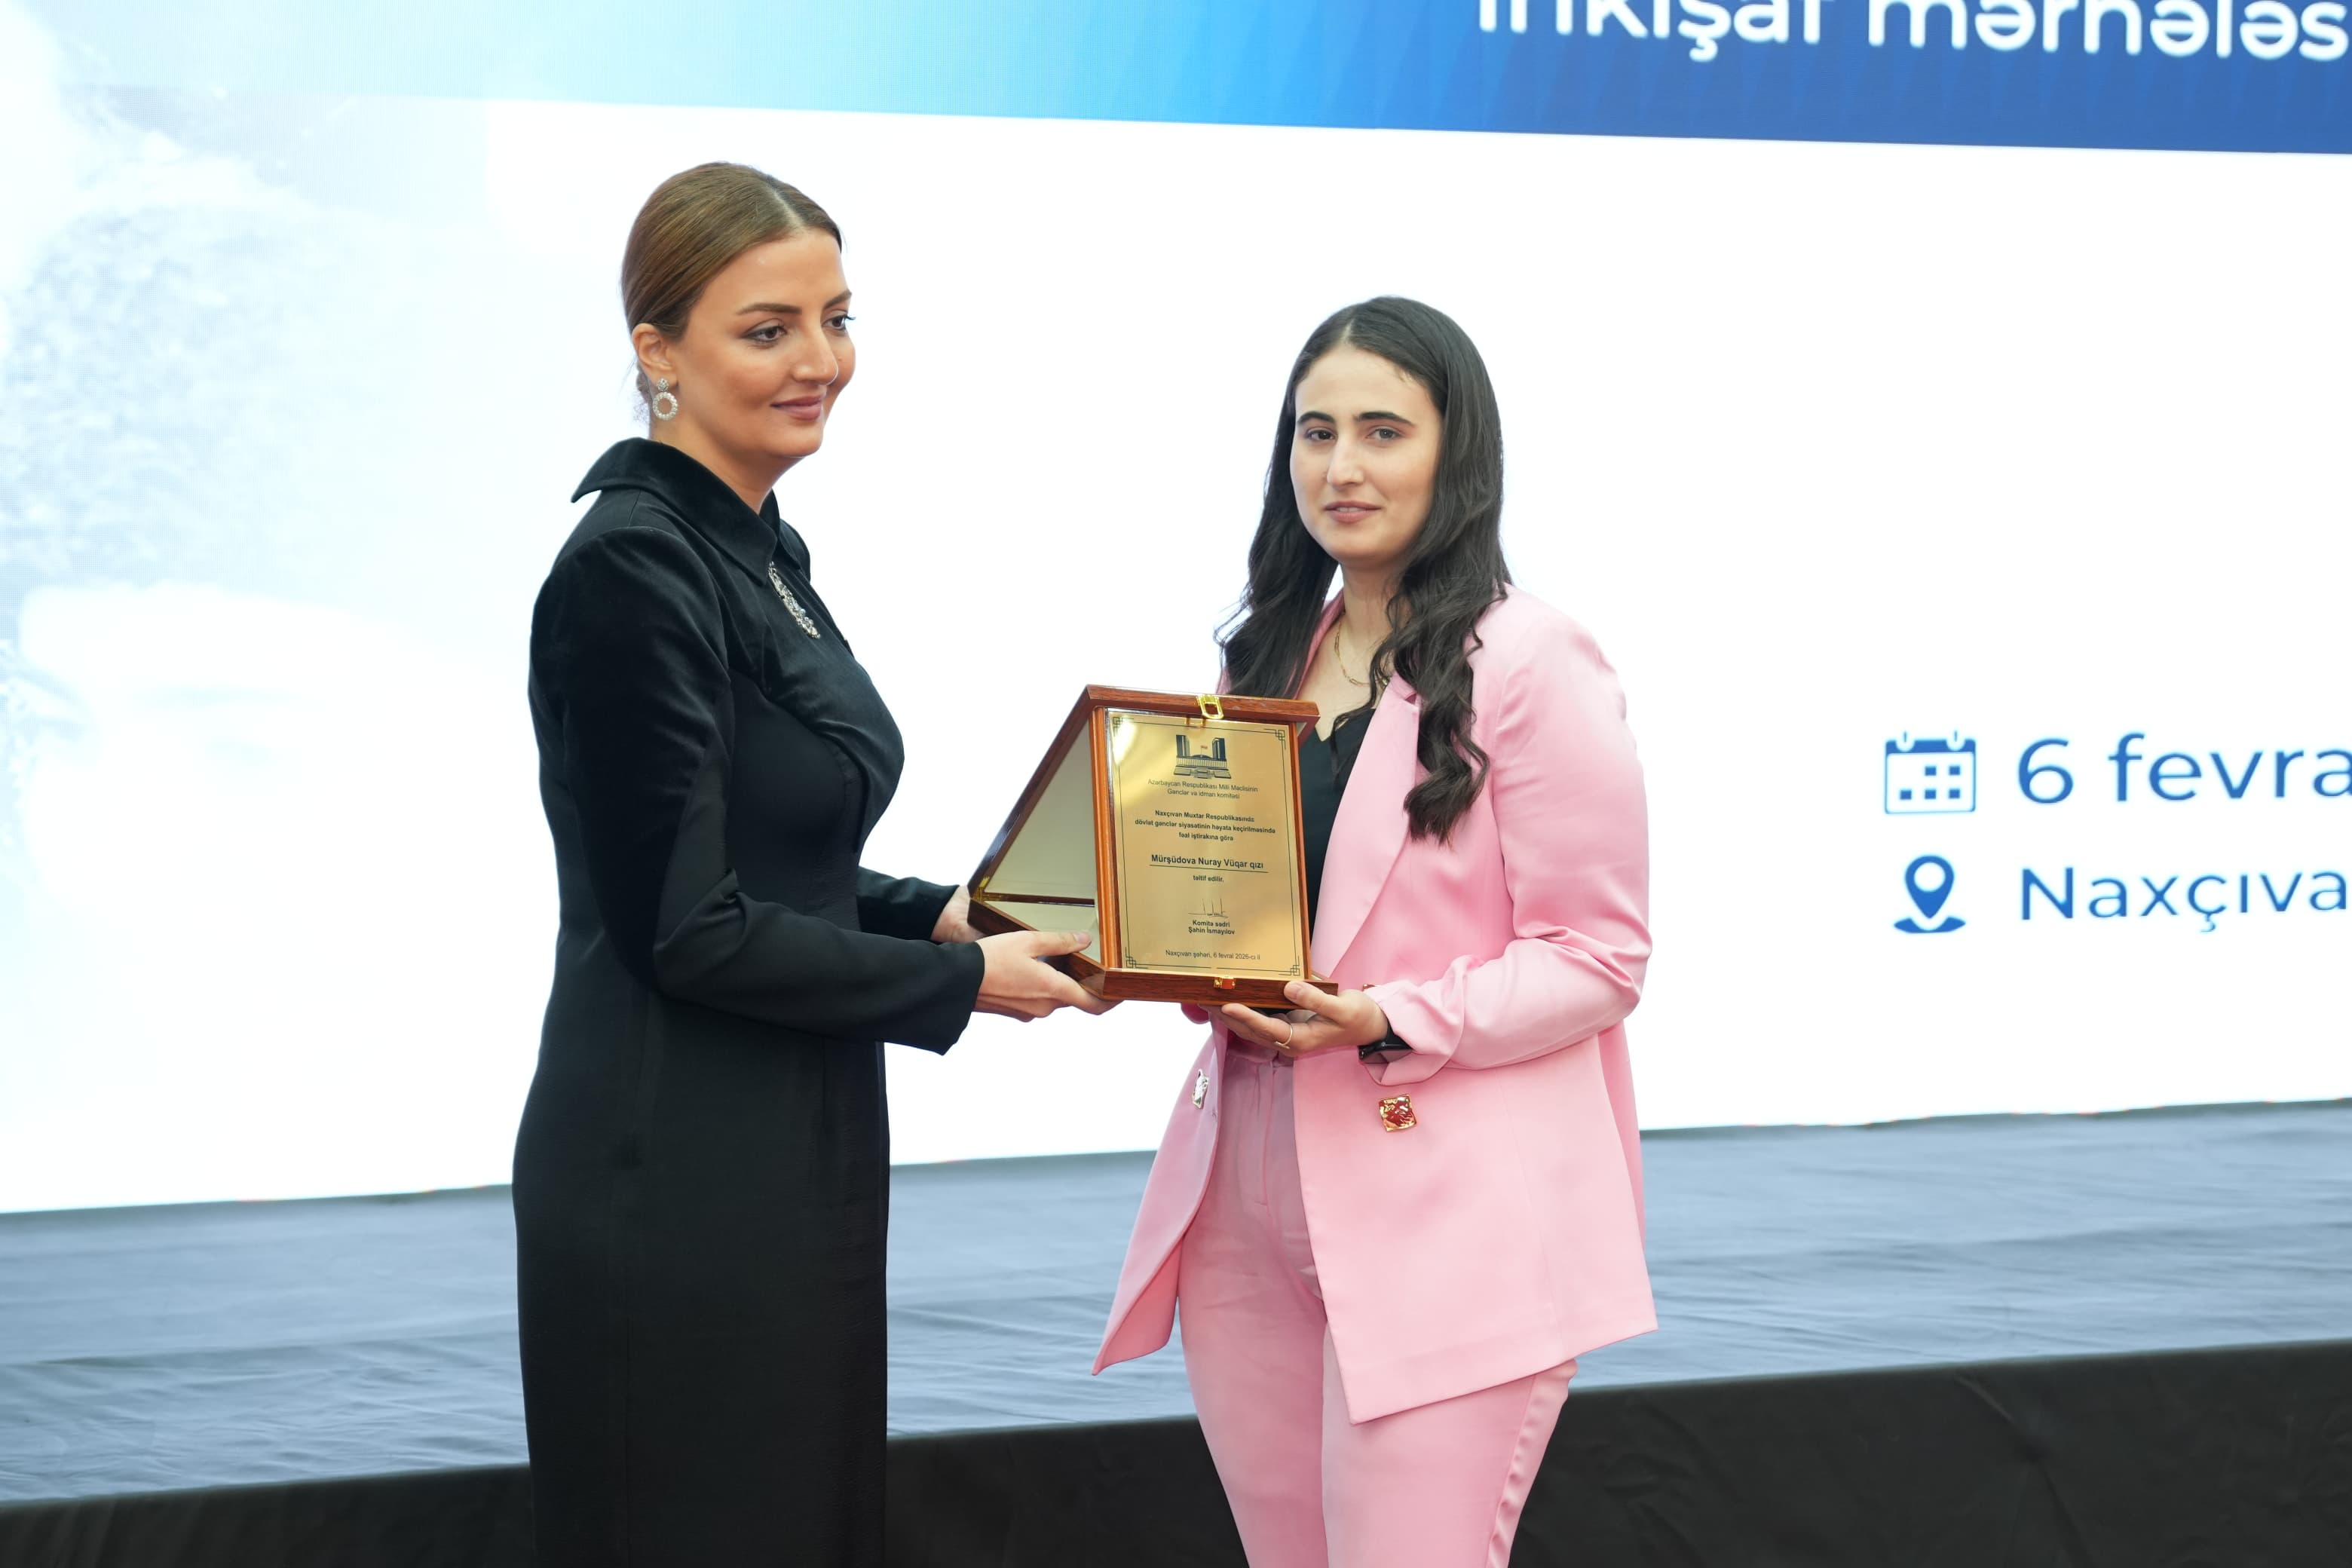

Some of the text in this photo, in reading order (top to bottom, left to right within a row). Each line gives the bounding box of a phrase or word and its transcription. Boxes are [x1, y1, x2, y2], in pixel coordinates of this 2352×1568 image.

[2017, 731, 2352, 804] 6 fevra
[1155, 810, 1183, 819] Naxçıvan
[1205, 813, 1255, 822] Respublikasında
[1135, 818, 1153, 826] dövlət
[1154, 819, 1177, 828] gənclər
[1178, 821, 1211, 830] siyasətinin
[1211, 822, 1232, 832] həyata
[1191, 832, 1219, 841] iştirakına
[1220, 834, 1234, 842] görə
[1150, 854, 1264, 870] Mürşüdova Nuray Vüqar qızı
[2022, 867, 2347, 933] Naxçıva
[1206, 927, 1236, 936] İsmayılov
[1165, 949, 1192, 958] Naxçıvan
